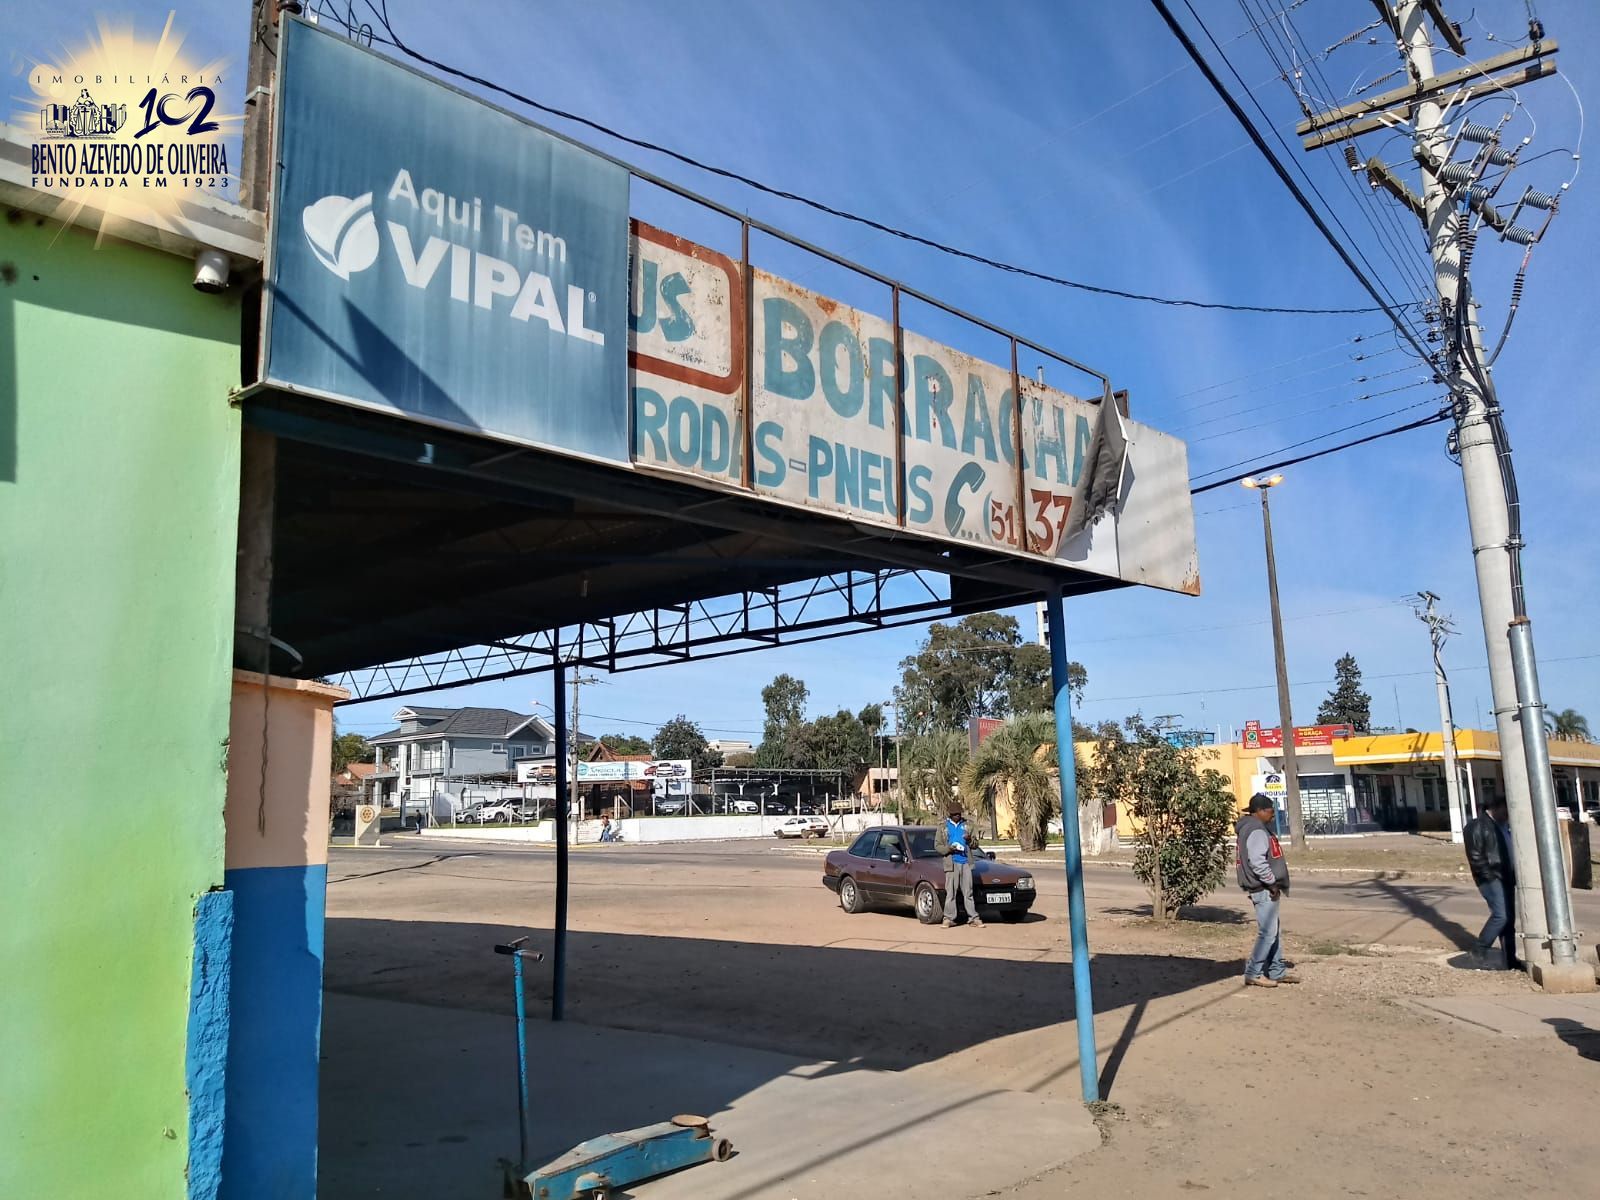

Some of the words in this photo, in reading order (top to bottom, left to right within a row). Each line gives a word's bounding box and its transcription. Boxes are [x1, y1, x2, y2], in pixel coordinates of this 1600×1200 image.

[387, 168, 482, 232] Aqui
[494, 204, 567, 262] Tem
[387, 220, 605, 346] VIPAL
